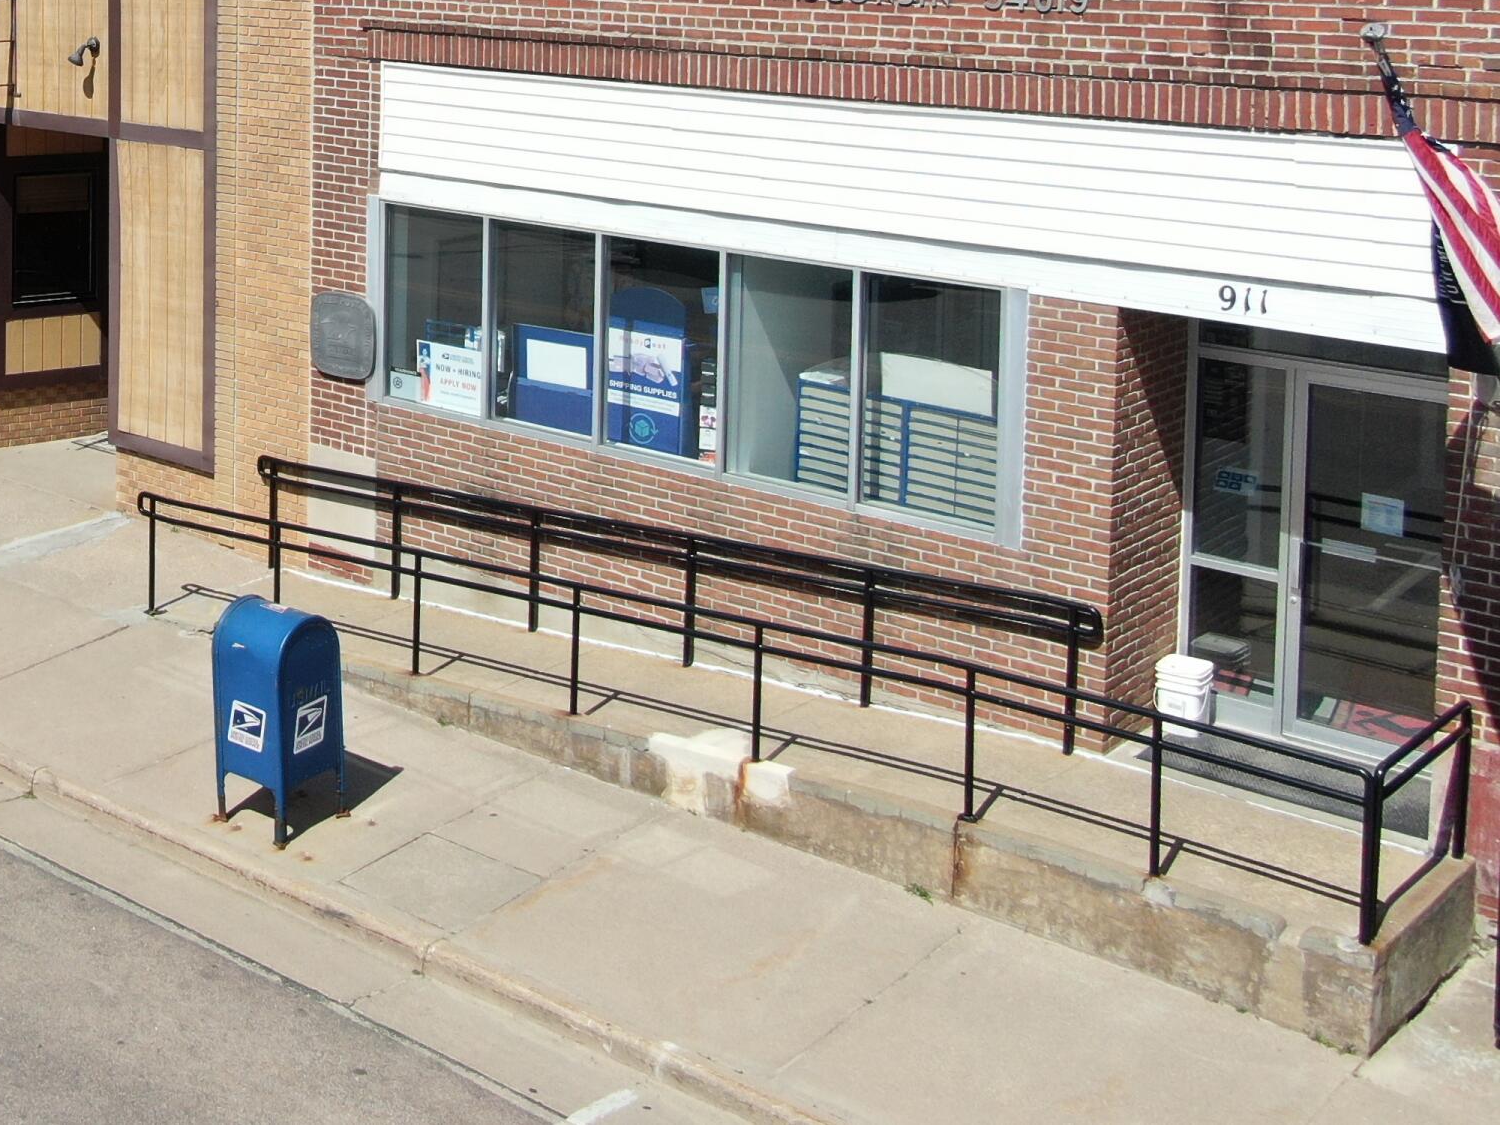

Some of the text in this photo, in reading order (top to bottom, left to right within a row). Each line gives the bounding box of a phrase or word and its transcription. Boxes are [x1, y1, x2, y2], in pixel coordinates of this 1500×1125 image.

[1218, 285, 1268, 315] 911
[435, 363, 481, 379] NOW HIRING
[440, 378, 477, 391] APPLY NOW
[609, 379, 678, 399] SHIPPING SUPPLIES
